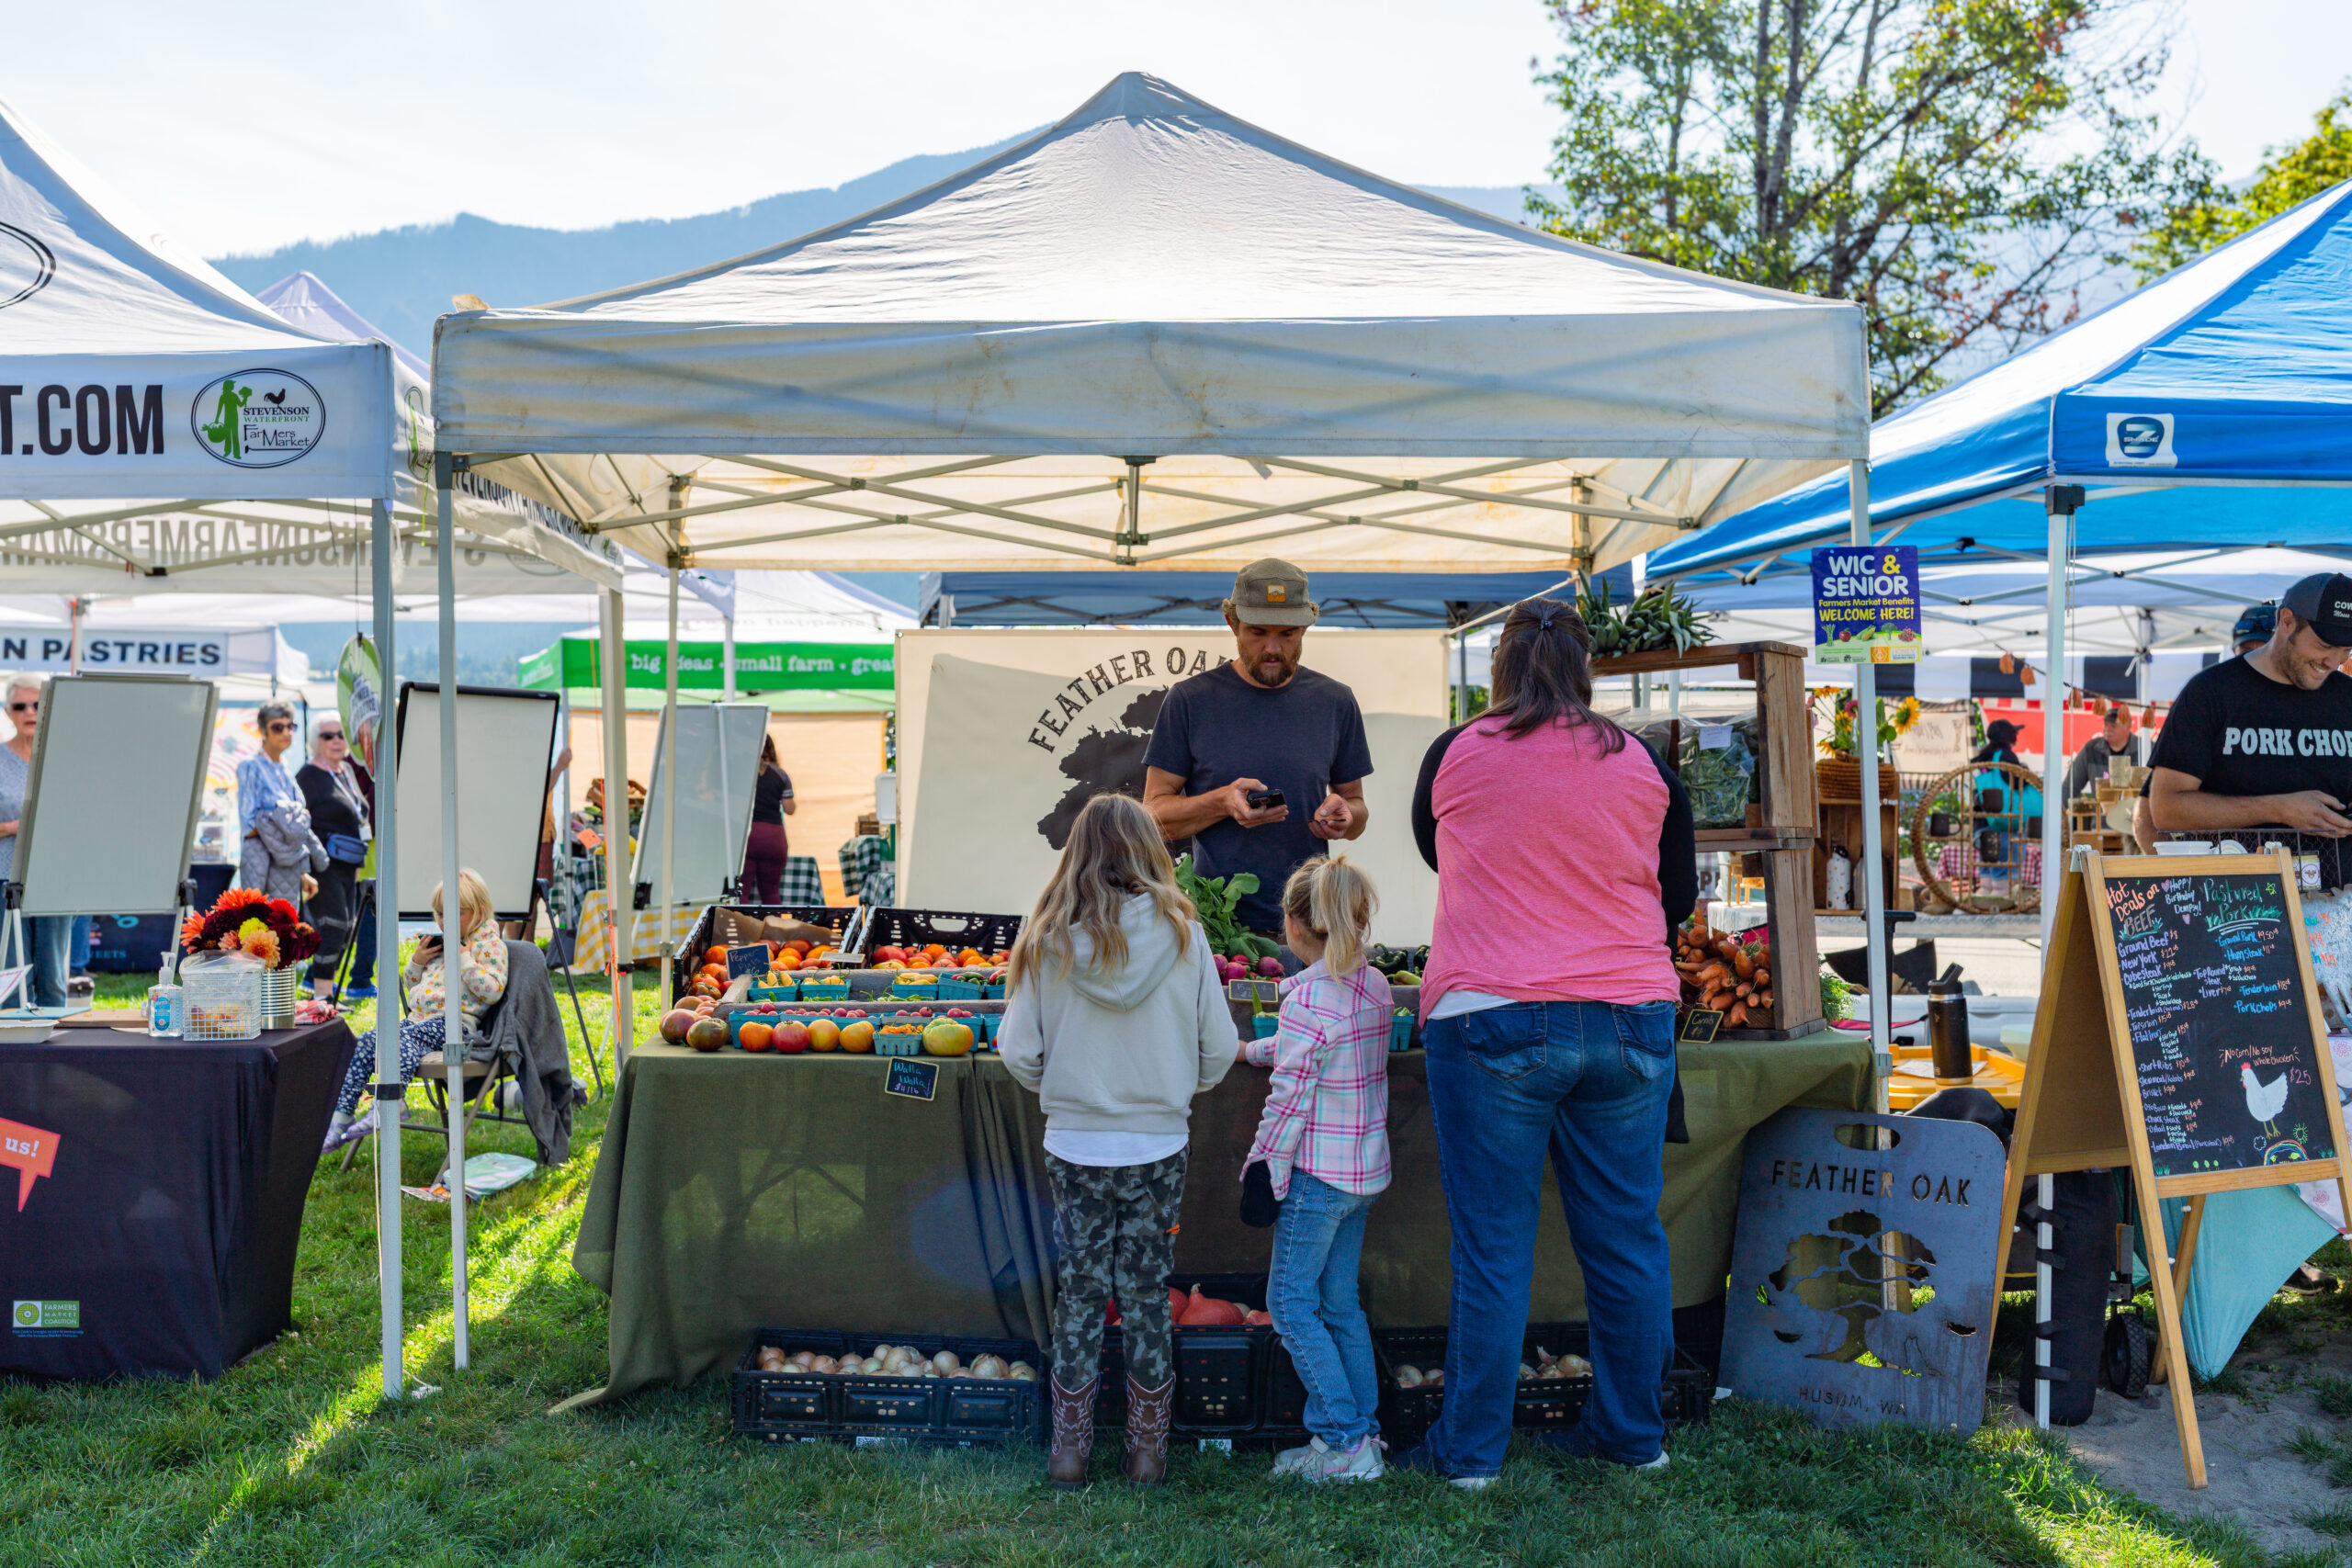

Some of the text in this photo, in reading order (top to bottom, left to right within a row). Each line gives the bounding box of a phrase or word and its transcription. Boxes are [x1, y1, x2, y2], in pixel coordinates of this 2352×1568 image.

[243, 407, 310, 415] STEVENSON
[1828, 555, 1900, 575] WIC &
[1823, 576, 1908, 597] SENIOR
[1819, 596, 1915, 607] Farmers Market Benefits
[1819, 607, 1915, 622] WELCOME HERE!
[3, 638, 27, 660] N
[631, 653, 661, 674] big
[676, 654, 713, 671] deas
[787, 655, 834, 671] farm
[1028, 649, 1156, 753] FEATHER
[2222, 727, 2294, 756] PORK
[2106, 881, 2129, 909] Hot
[2169, 876, 2192, 893] Happy
[2115, 884, 2160, 922] Deals on
[2219, 903, 2248, 923] Pork
[2124, 904, 2155, 936] BEEF
[2118, 938, 2150, 957] Ground
[2148, 931, 2169, 948] Beef
[894, 1061, 922, 1076] Walla
[2290, 1066, 2312, 1086] $25
[899, 1074, 927, 1089] Walla
[5, 1136, 40, 1158] us!
[1772, 1160, 1971, 1207] FEATHER OAK
